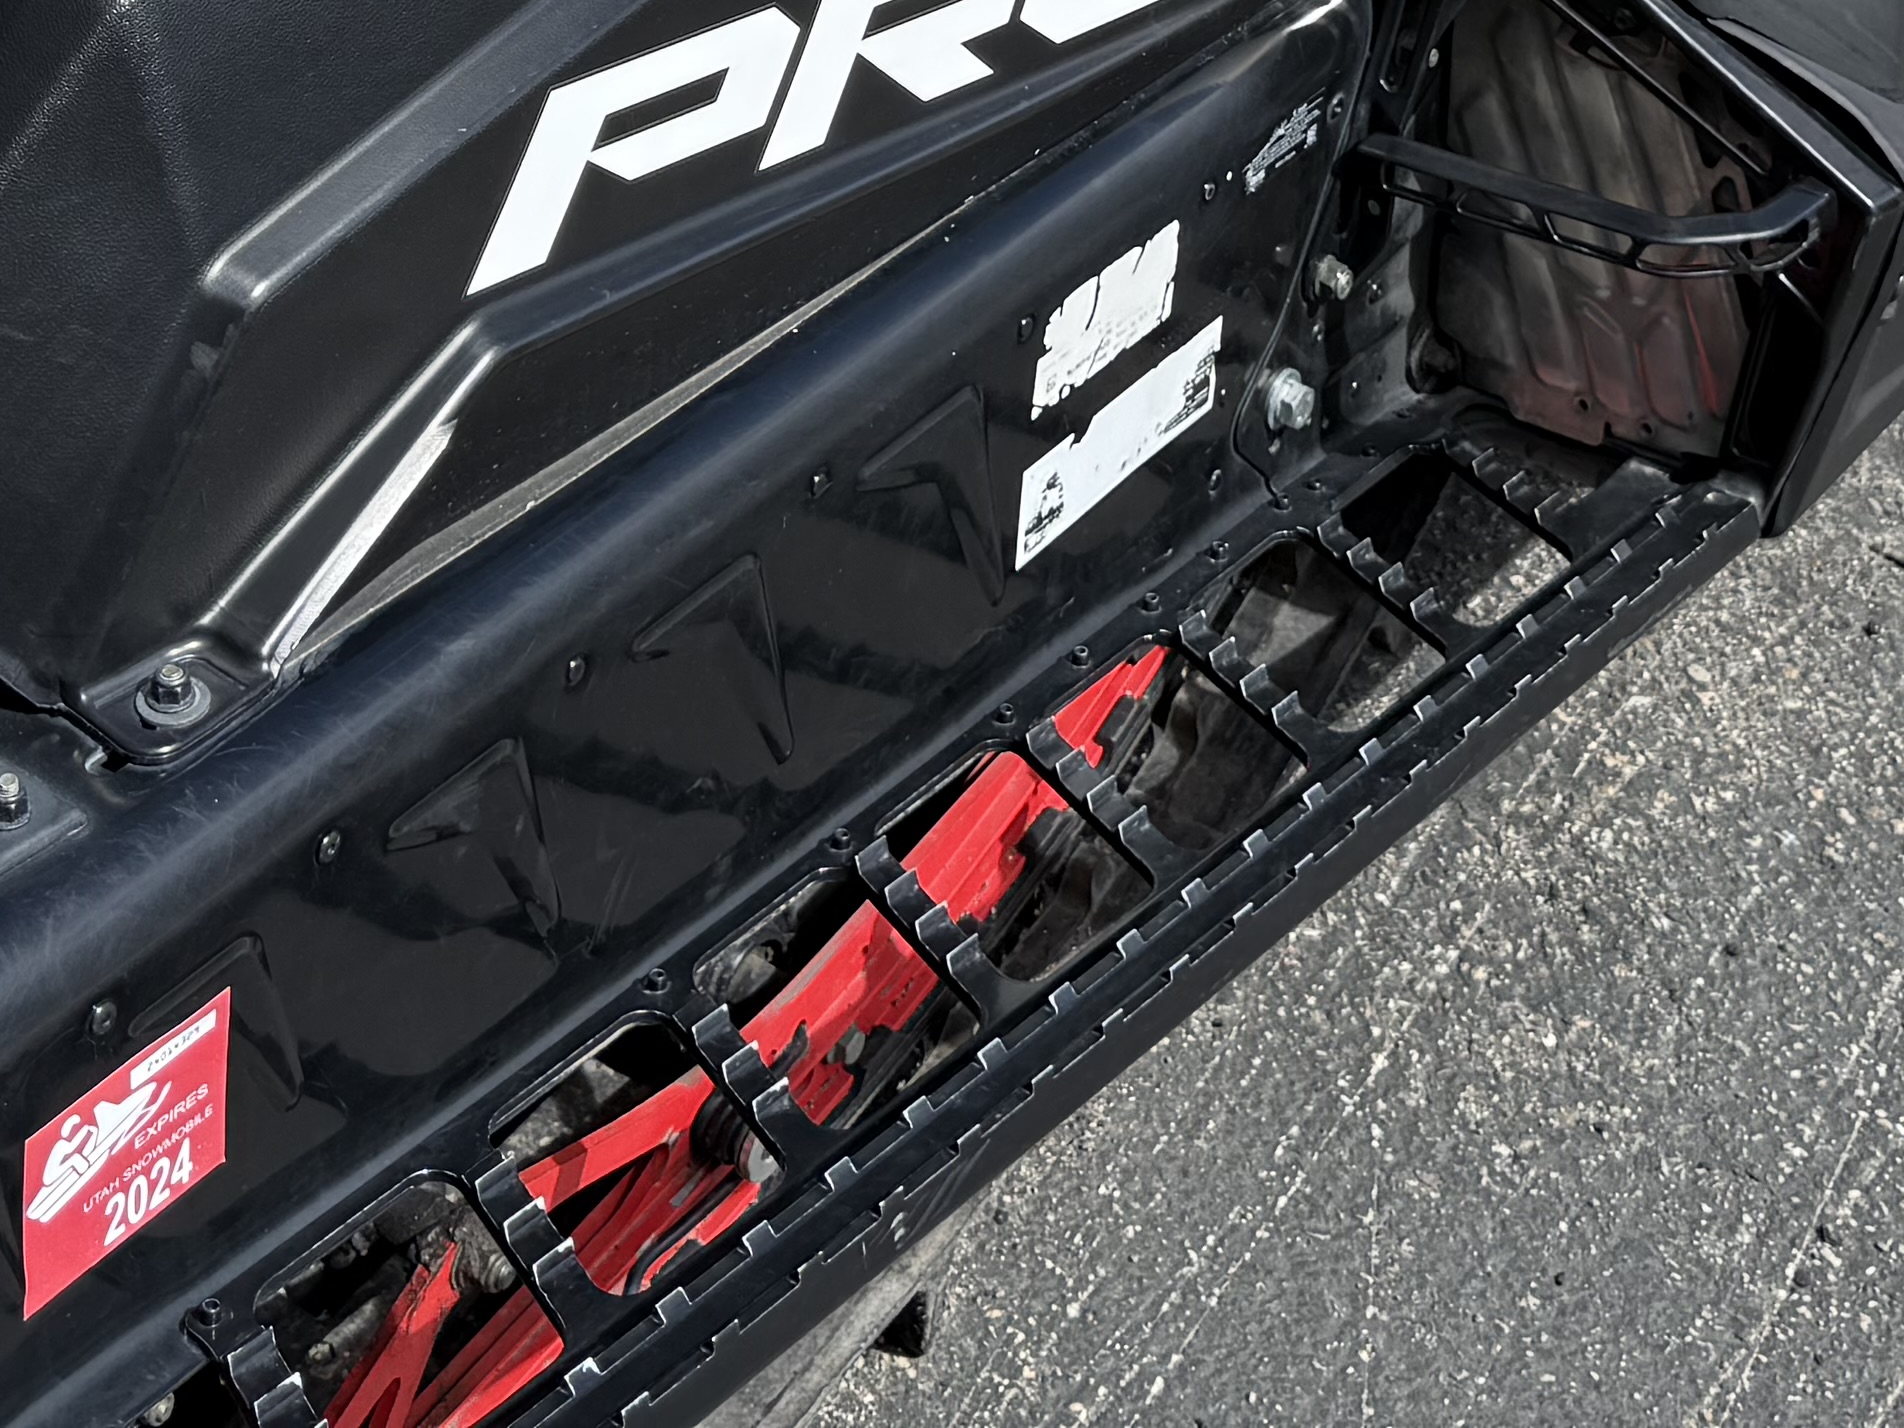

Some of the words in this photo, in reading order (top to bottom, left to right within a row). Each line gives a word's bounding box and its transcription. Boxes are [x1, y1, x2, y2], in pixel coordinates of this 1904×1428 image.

[83, 1179, 120, 1214] UTAH
[122, 1103, 214, 1182] SNOWMOBILE
[134, 1083, 209, 1150] EXPIRES
[103, 1137, 193, 1247] 2024
